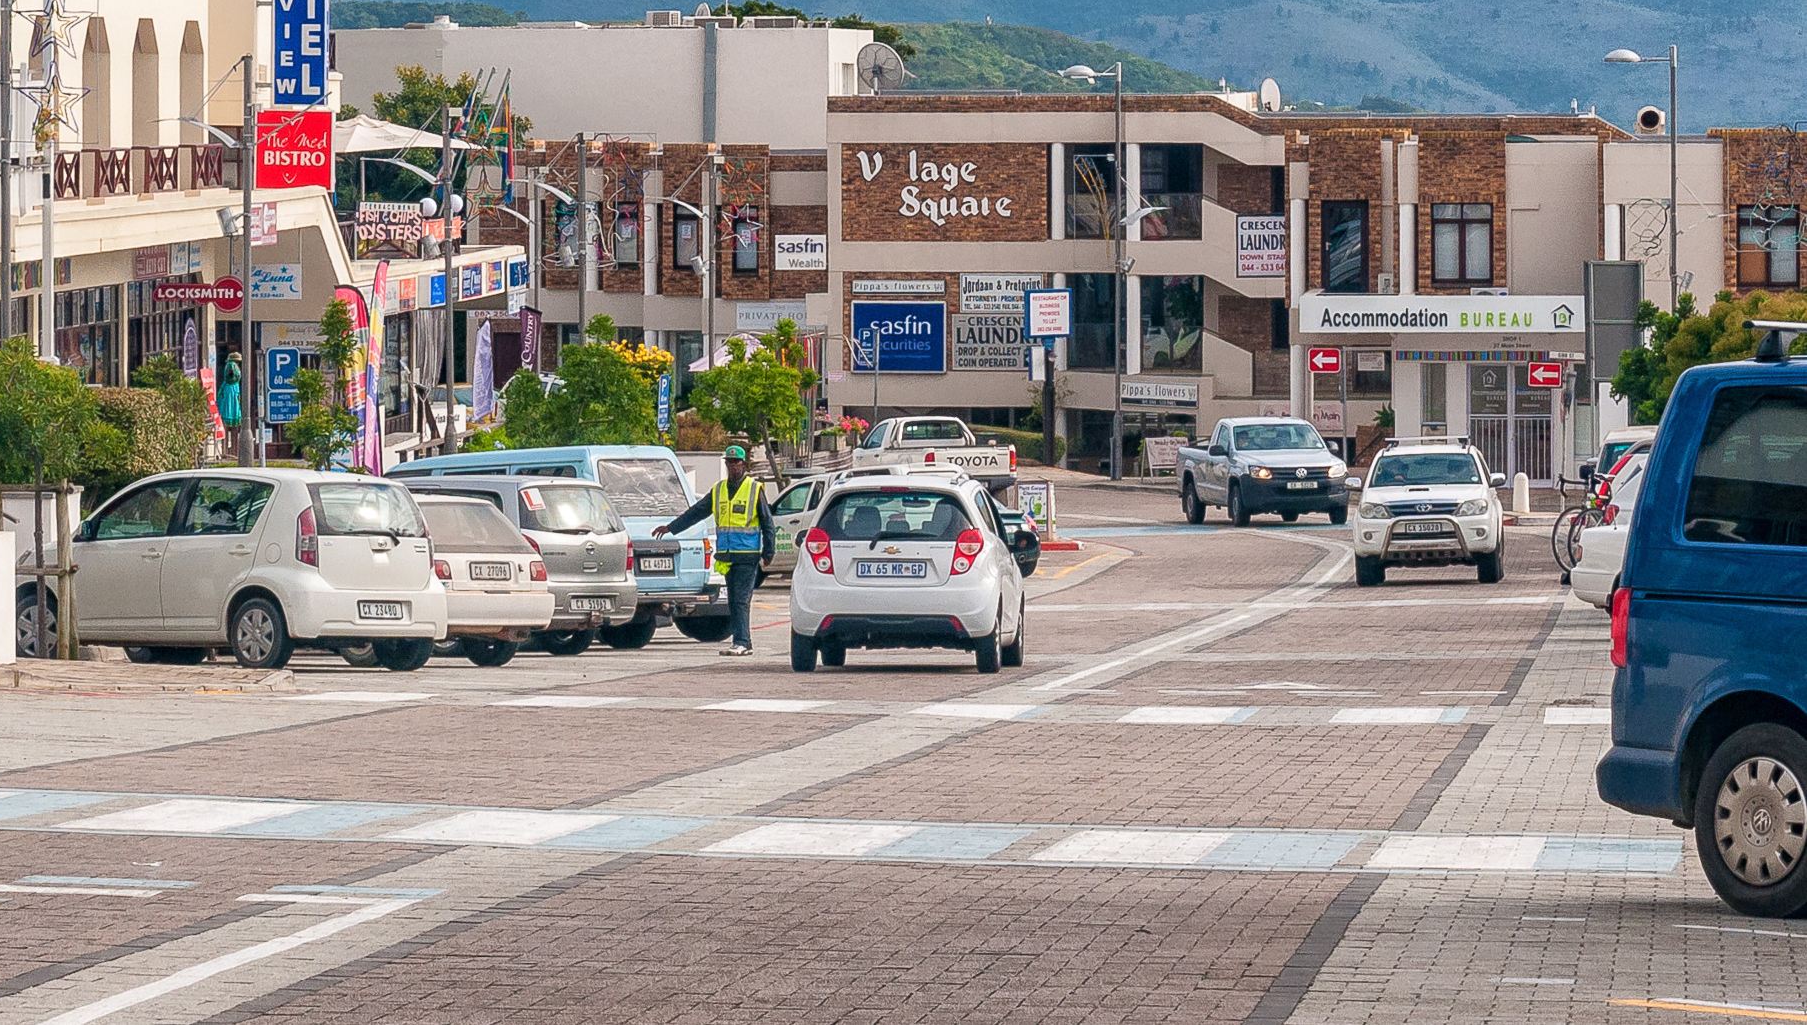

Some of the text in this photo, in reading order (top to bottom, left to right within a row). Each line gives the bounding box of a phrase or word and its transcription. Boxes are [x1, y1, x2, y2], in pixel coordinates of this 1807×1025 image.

[294, 130, 328, 149] Med
[263, 150, 326, 167] BISTRO
[359, 211, 380, 223] FISH
[389, 210, 422, 225] CHIPS
[358, 223, 422, 241] OYSTERS
[777, 237, 824, 254] sasfin
[788, 258, 824, 268] Wealth
[259, 271, 295, 284] Luna
[854, 282, 931, 291] Pippa's flowers
[963, 276, 1041, 294] Jordaan & Pretorius
[157, 288, 234, 299] LOCKSMITH
[738, 312, 782, 320] PRIVATE
[1320, 308, 1533, 328] Accommodation BUREAU
[870, 314, 931, 335] sasfin
[862, 330, 871, 340] P
[958, 347, 978, 356] DROP
[987, 346, 1022, 356] COLLECT
[276, 354, 291, 371] P
[958, 357, 1018, 367] COIN OPERATED
[274, 375, 283, 385] 60
[1122, 384, 1186, 397] Pippa's flowers
[1320, 410, 1341, 422] Main
[946, 456, 999, 467] TOYOTA
[474, 565, 507, 578] CX 27096
[860, 564, 923, 575] DX 65 MR GP
[362, 604, 397, 617] CX 23480
